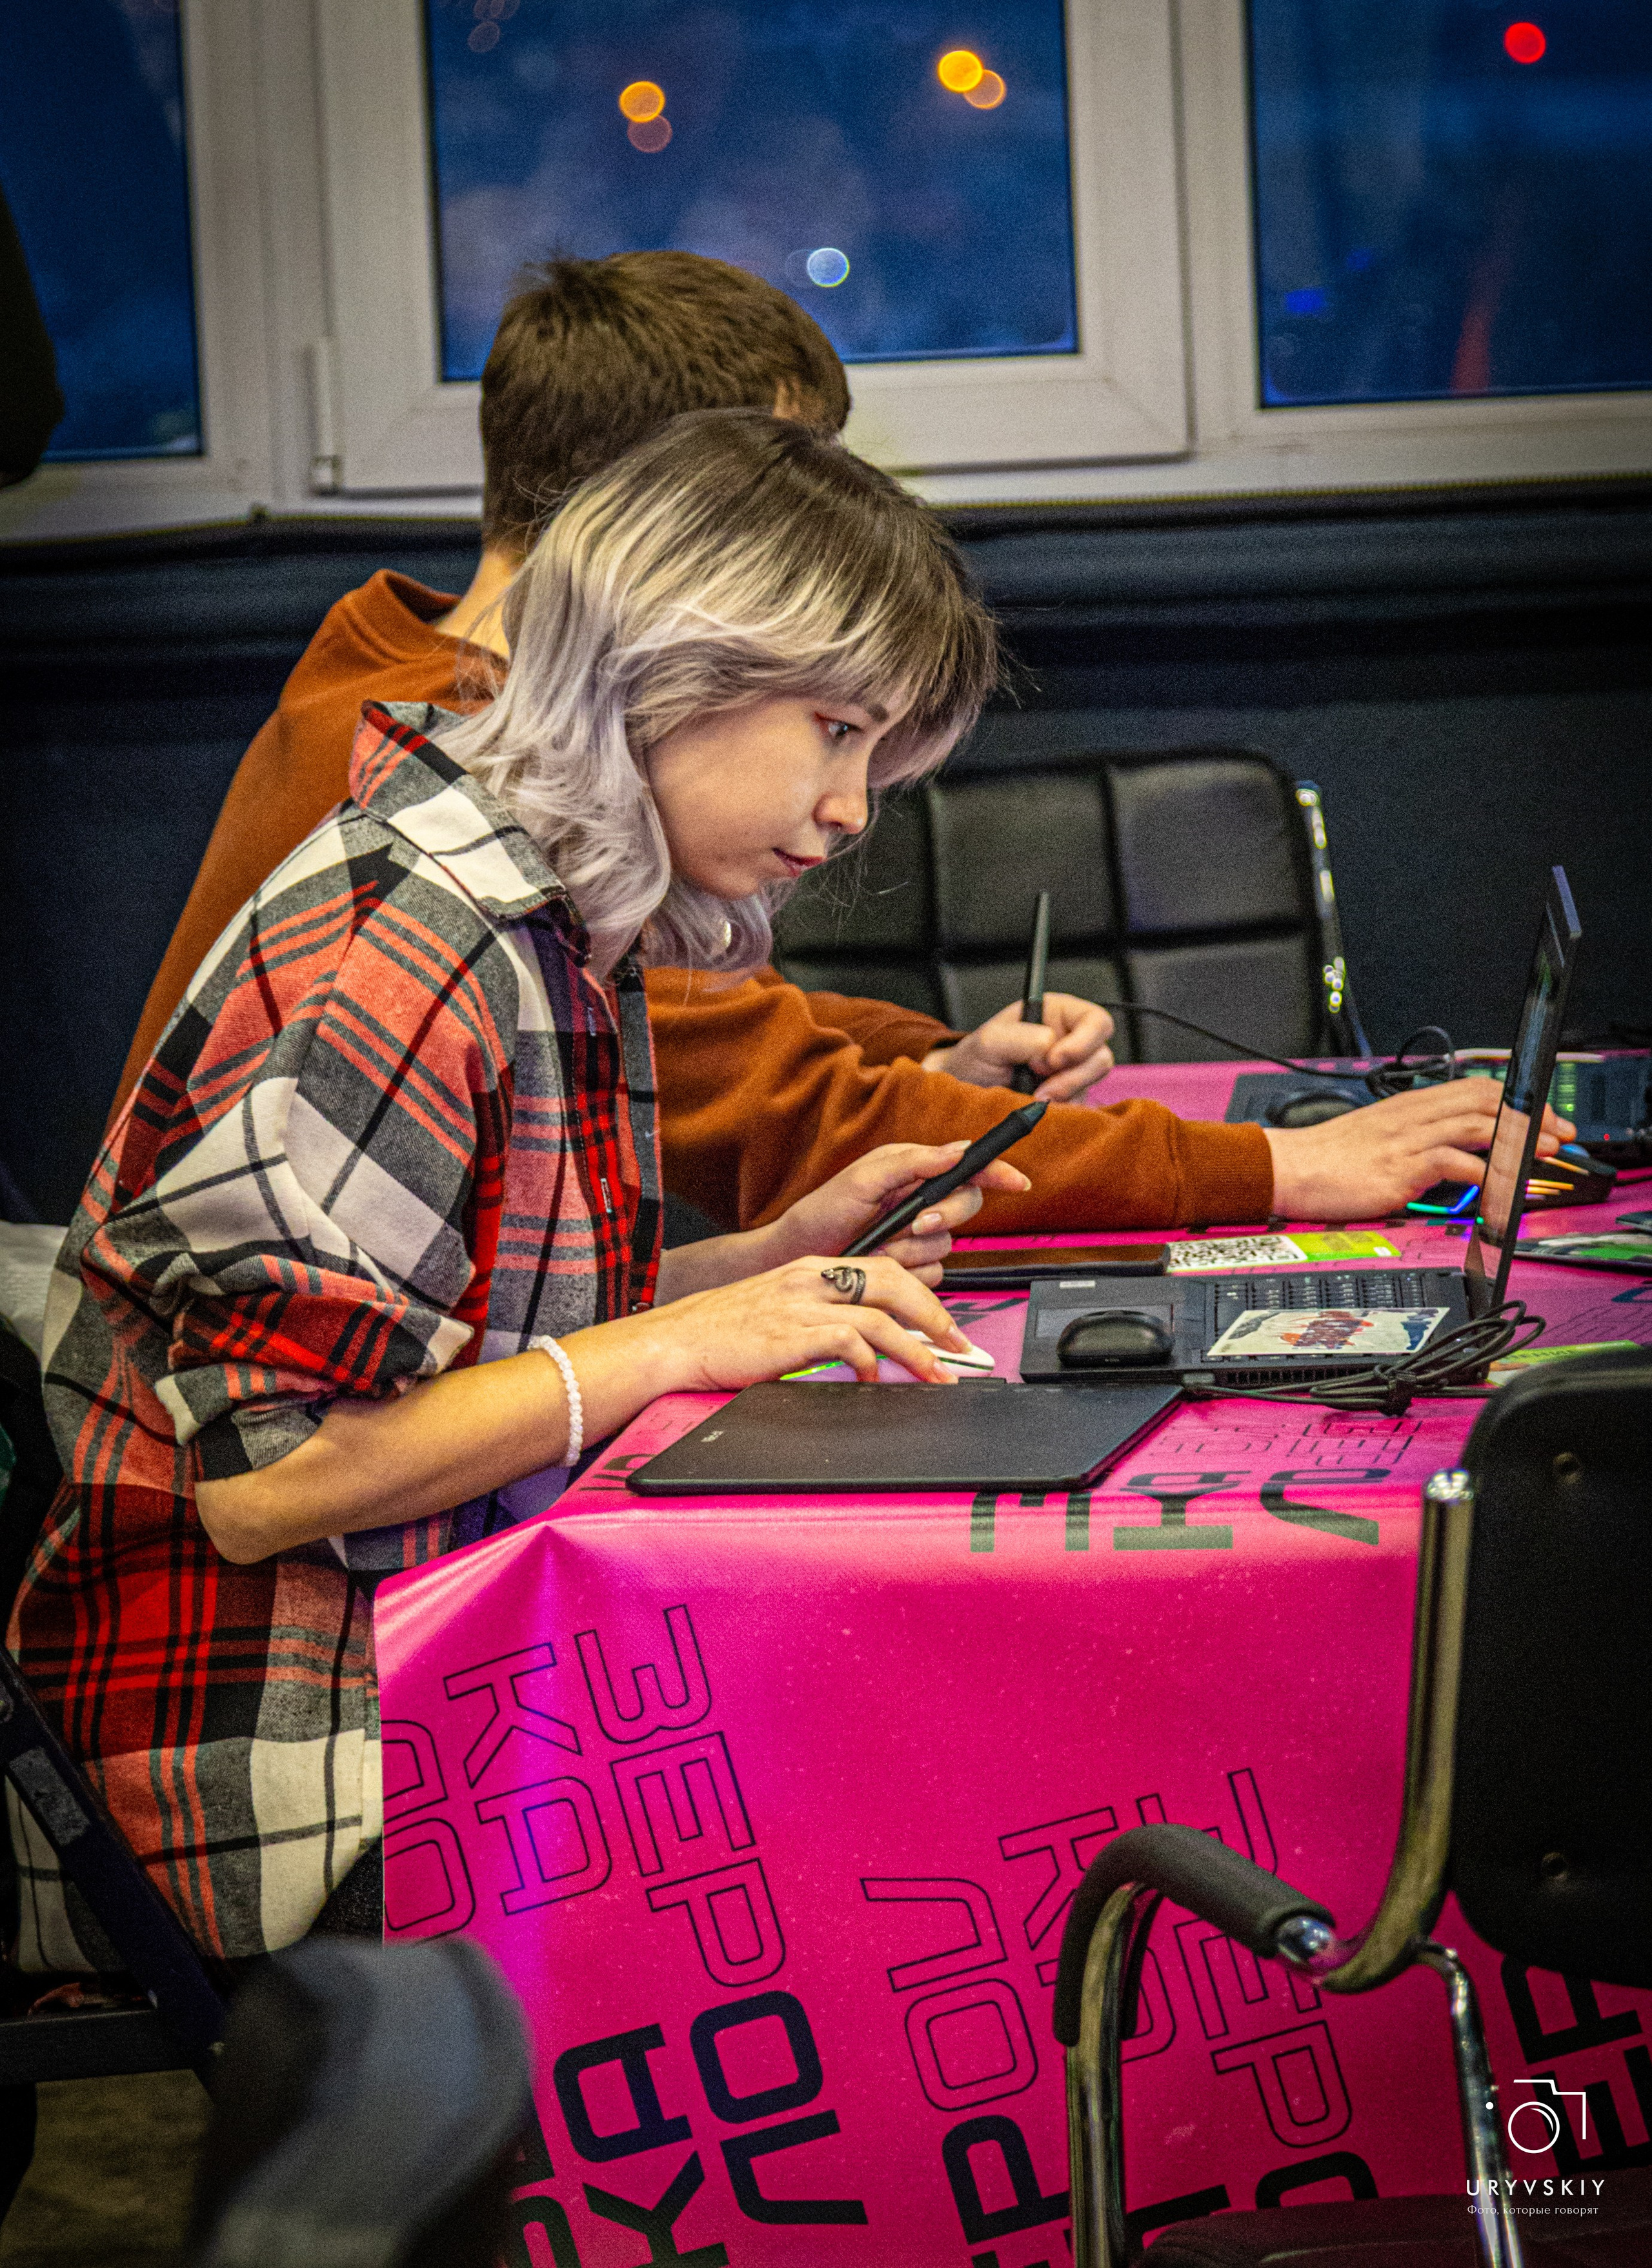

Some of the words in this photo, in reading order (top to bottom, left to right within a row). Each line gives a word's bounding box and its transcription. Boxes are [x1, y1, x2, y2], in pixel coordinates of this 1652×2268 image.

[443, 1643, 612, 1916] КА
[575, 1603, 787, 1988] ЗЕР
[689, 1990, 869, 2225] ЛО
[859, 1877, 1039, 2113] ЛО
